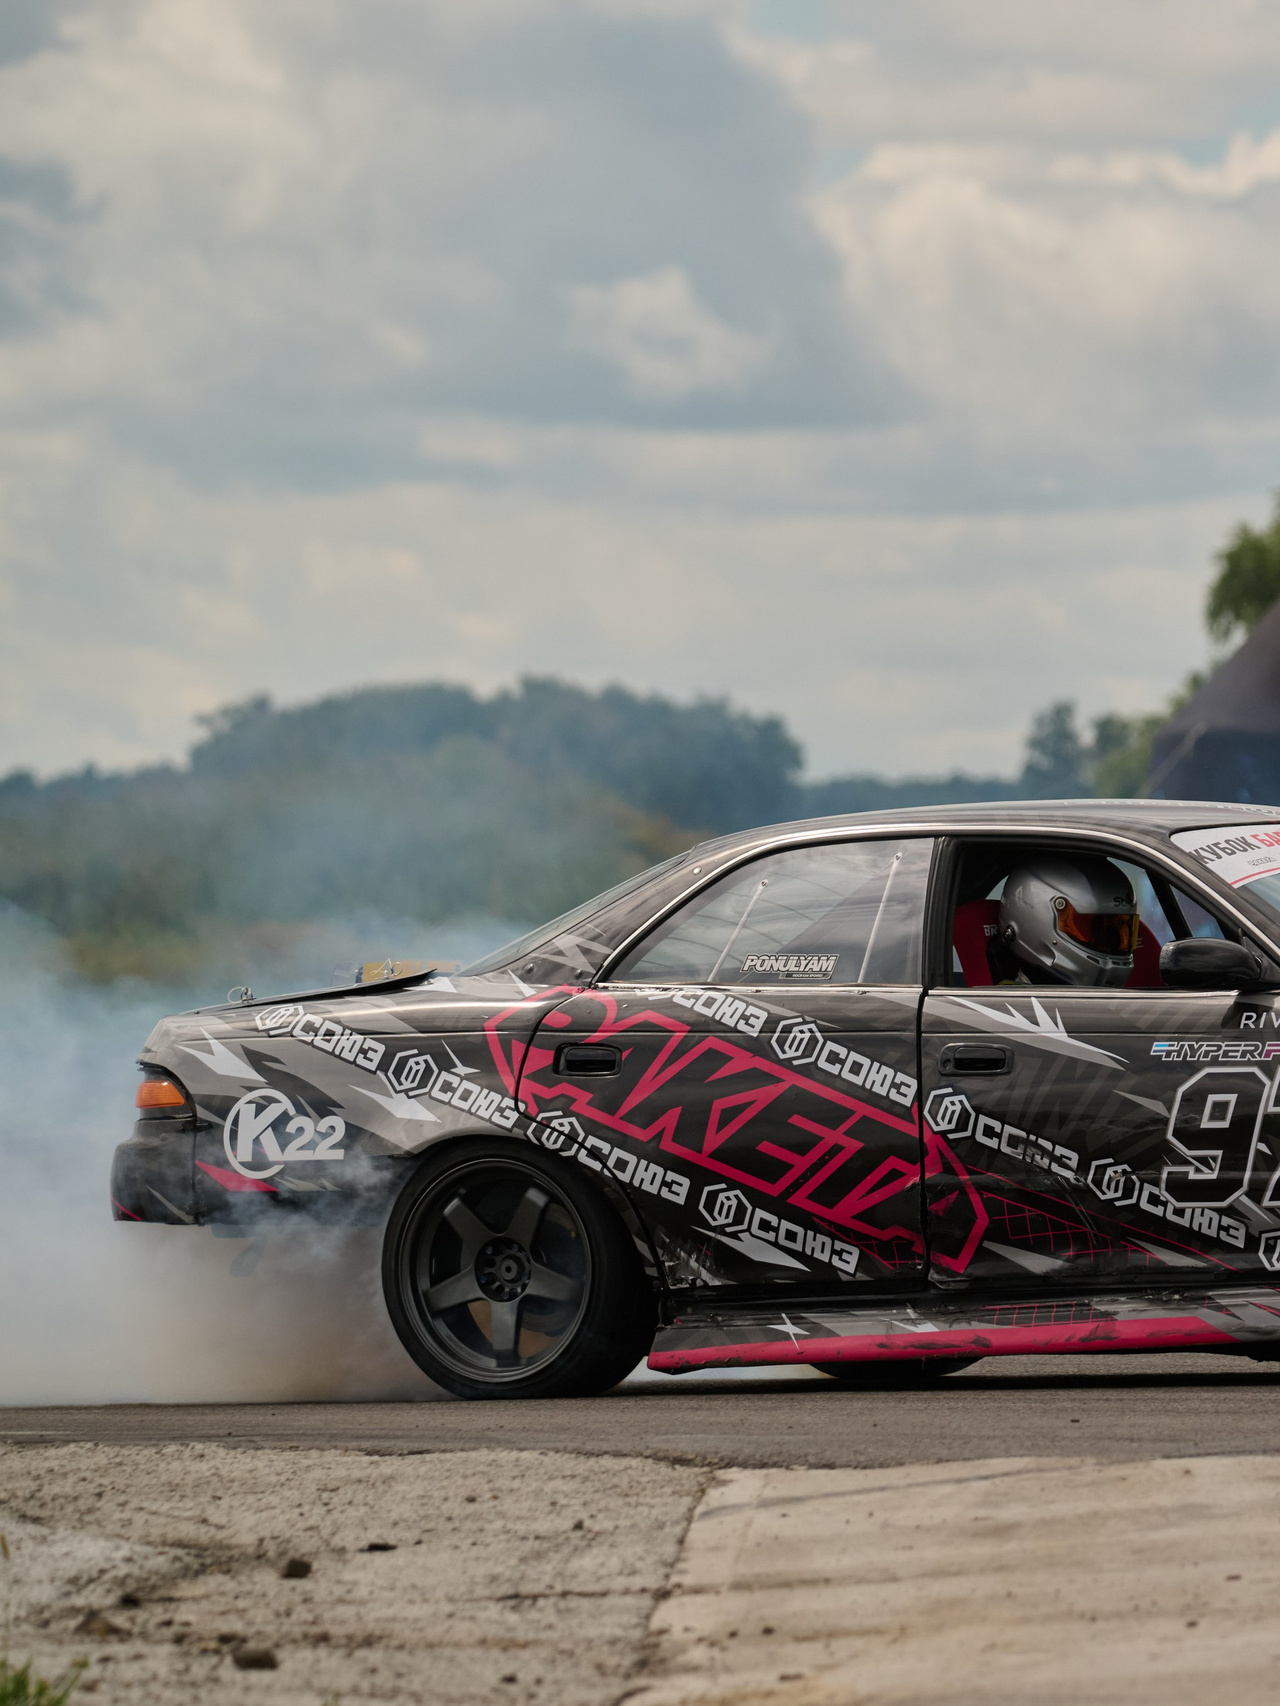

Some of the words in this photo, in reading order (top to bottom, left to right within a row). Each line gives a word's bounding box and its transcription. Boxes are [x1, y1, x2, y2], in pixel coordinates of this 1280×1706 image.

[1187, 836, 1262, 865] КУБОК
[742, 954, 838, 973] PONULYAM
[672, 988, 769, 1038] СОЮЗ
[817, 1040, 918, 1108] СОЮЗ
[230, 1098, 346, 1166] K22
[292, 1013, 386, 1073] СОЮЗ
[430, 1070, 526, 1129] СОЮЗ
[577, 1134, 691, 1206] СОЮЗ
[750, 1207, 861, 1275] СОЮЗ
